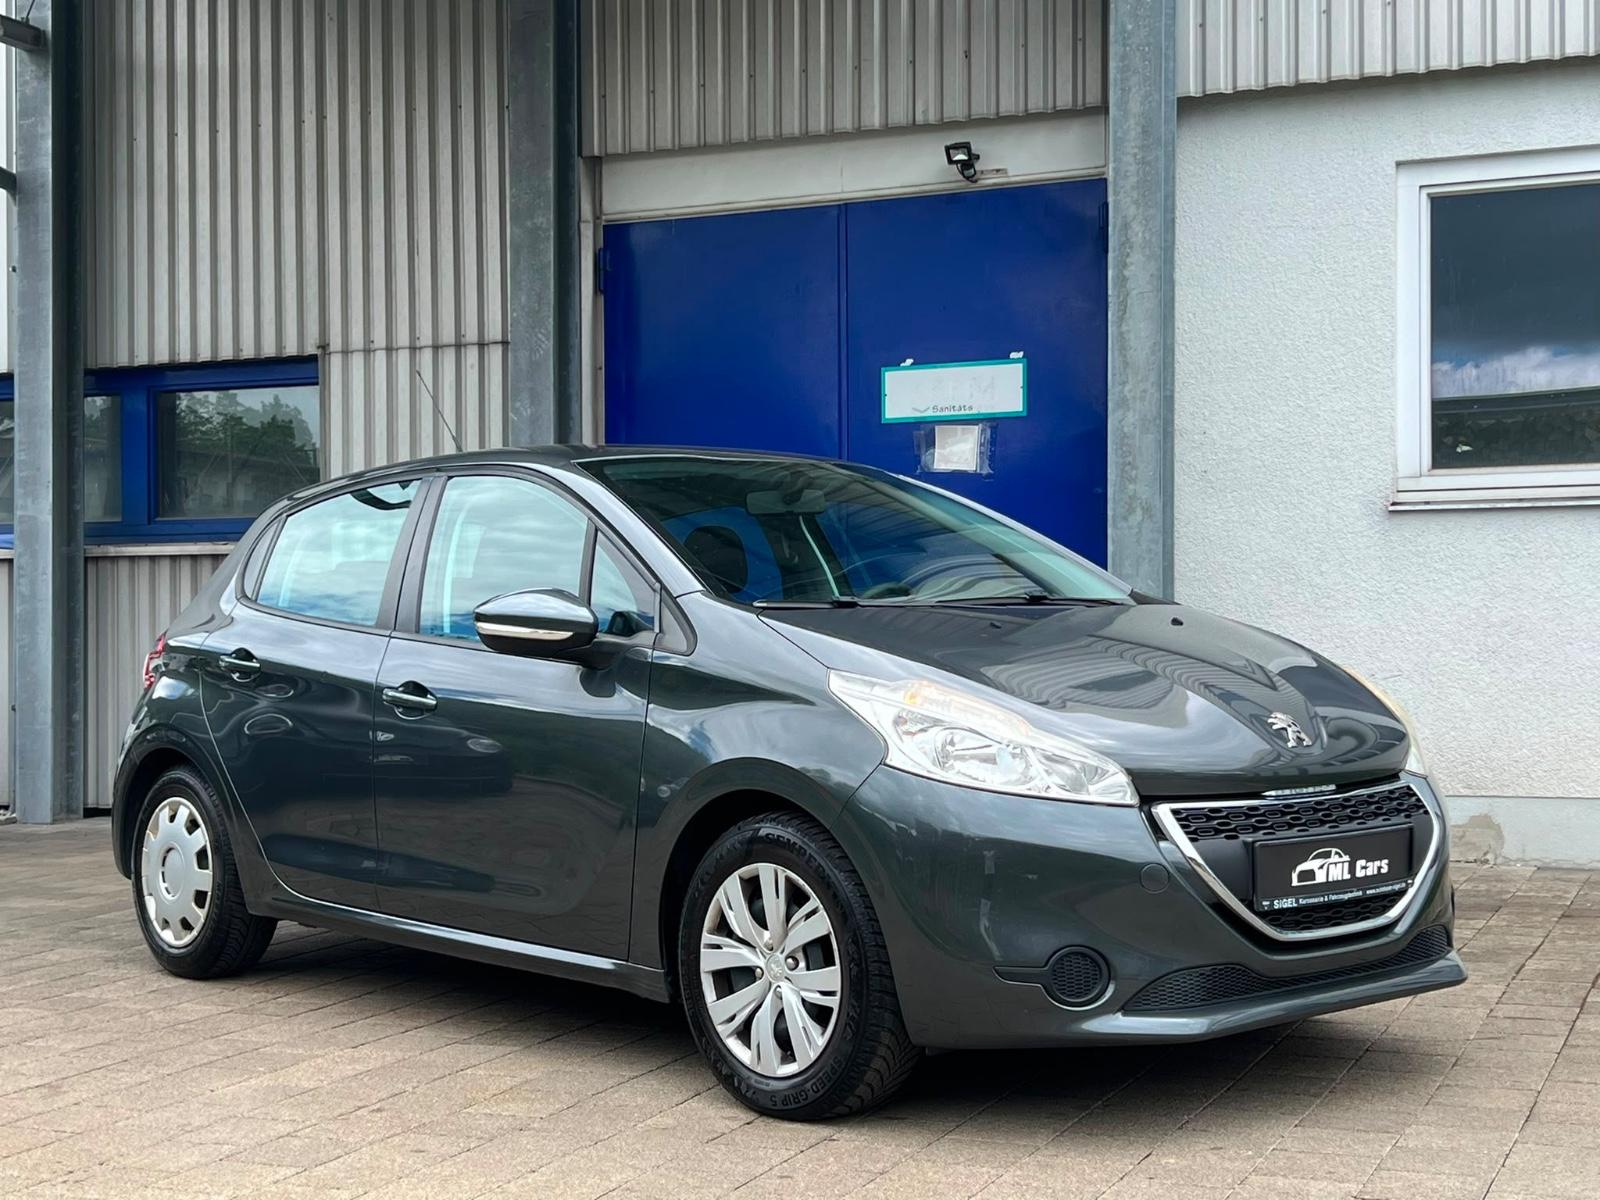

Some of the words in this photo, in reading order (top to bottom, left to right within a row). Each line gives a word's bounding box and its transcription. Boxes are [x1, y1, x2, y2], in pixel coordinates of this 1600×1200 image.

[1328, 862, 1351, 882] ML
[1355, 858, 1389, 878] Cars
[1273, 898, 1298, 909] SIGEL
